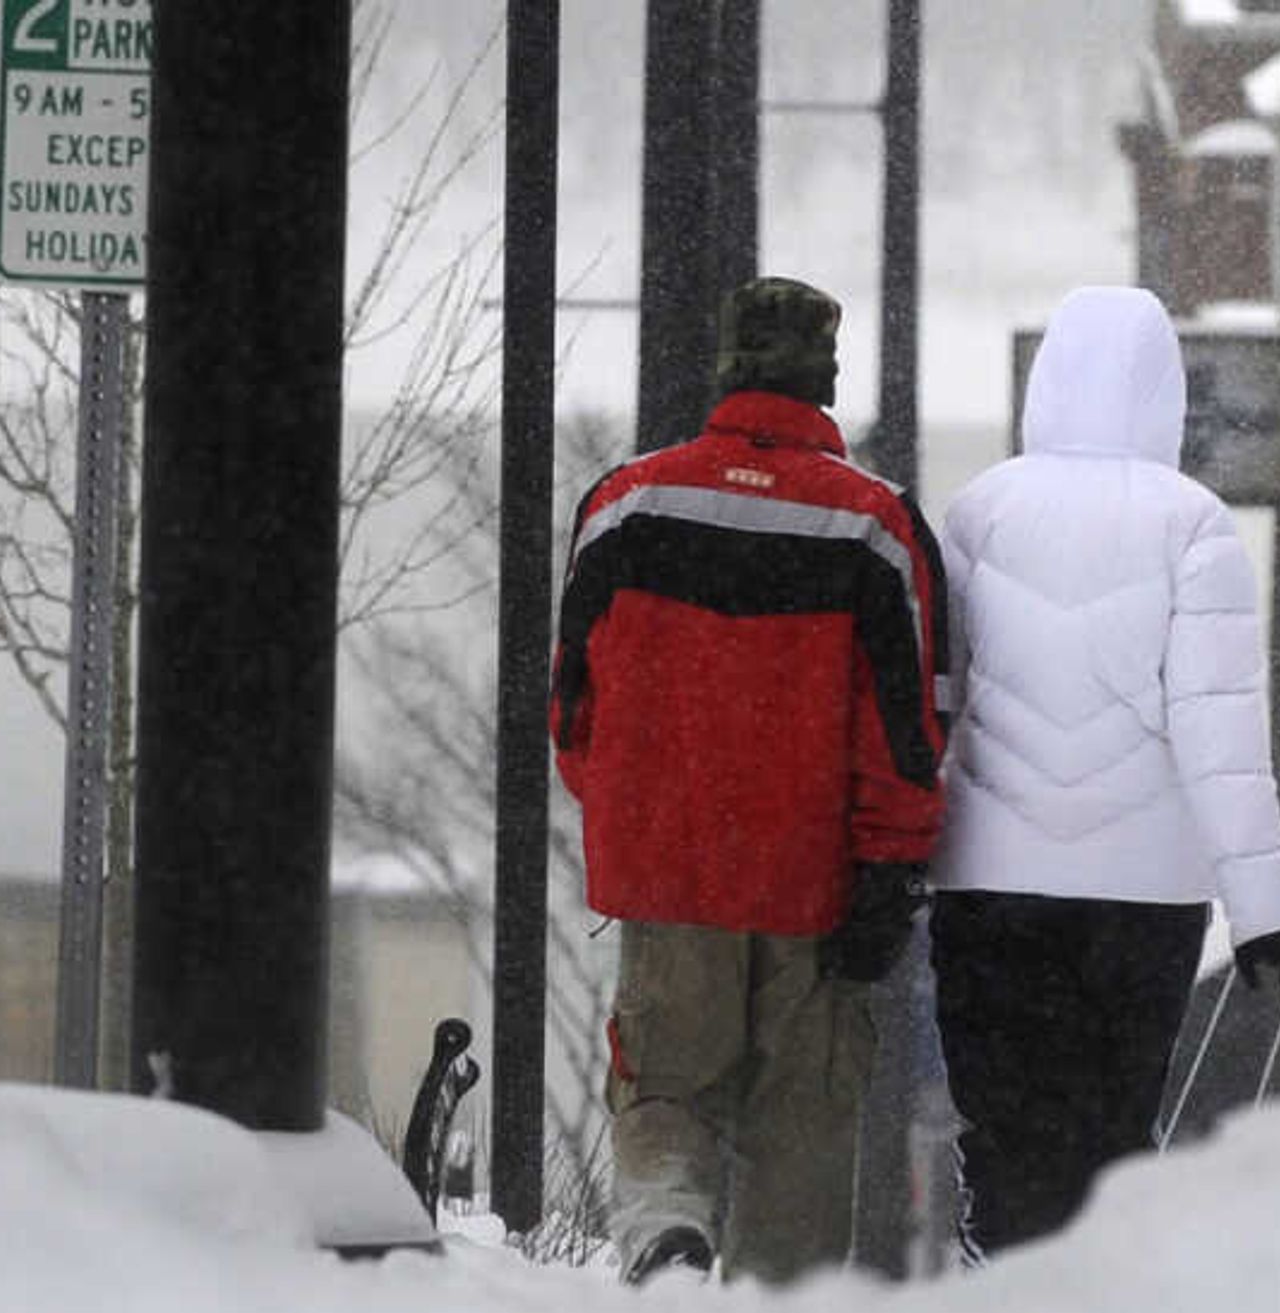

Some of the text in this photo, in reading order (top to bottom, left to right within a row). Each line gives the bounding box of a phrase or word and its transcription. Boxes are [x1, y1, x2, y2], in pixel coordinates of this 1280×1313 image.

[13, 0, 60, 50] 2
[39, 86, 84, 116] AM
[130, 88, 147, 119] 5
[8, 181, 134, 216] SUNDAYS
